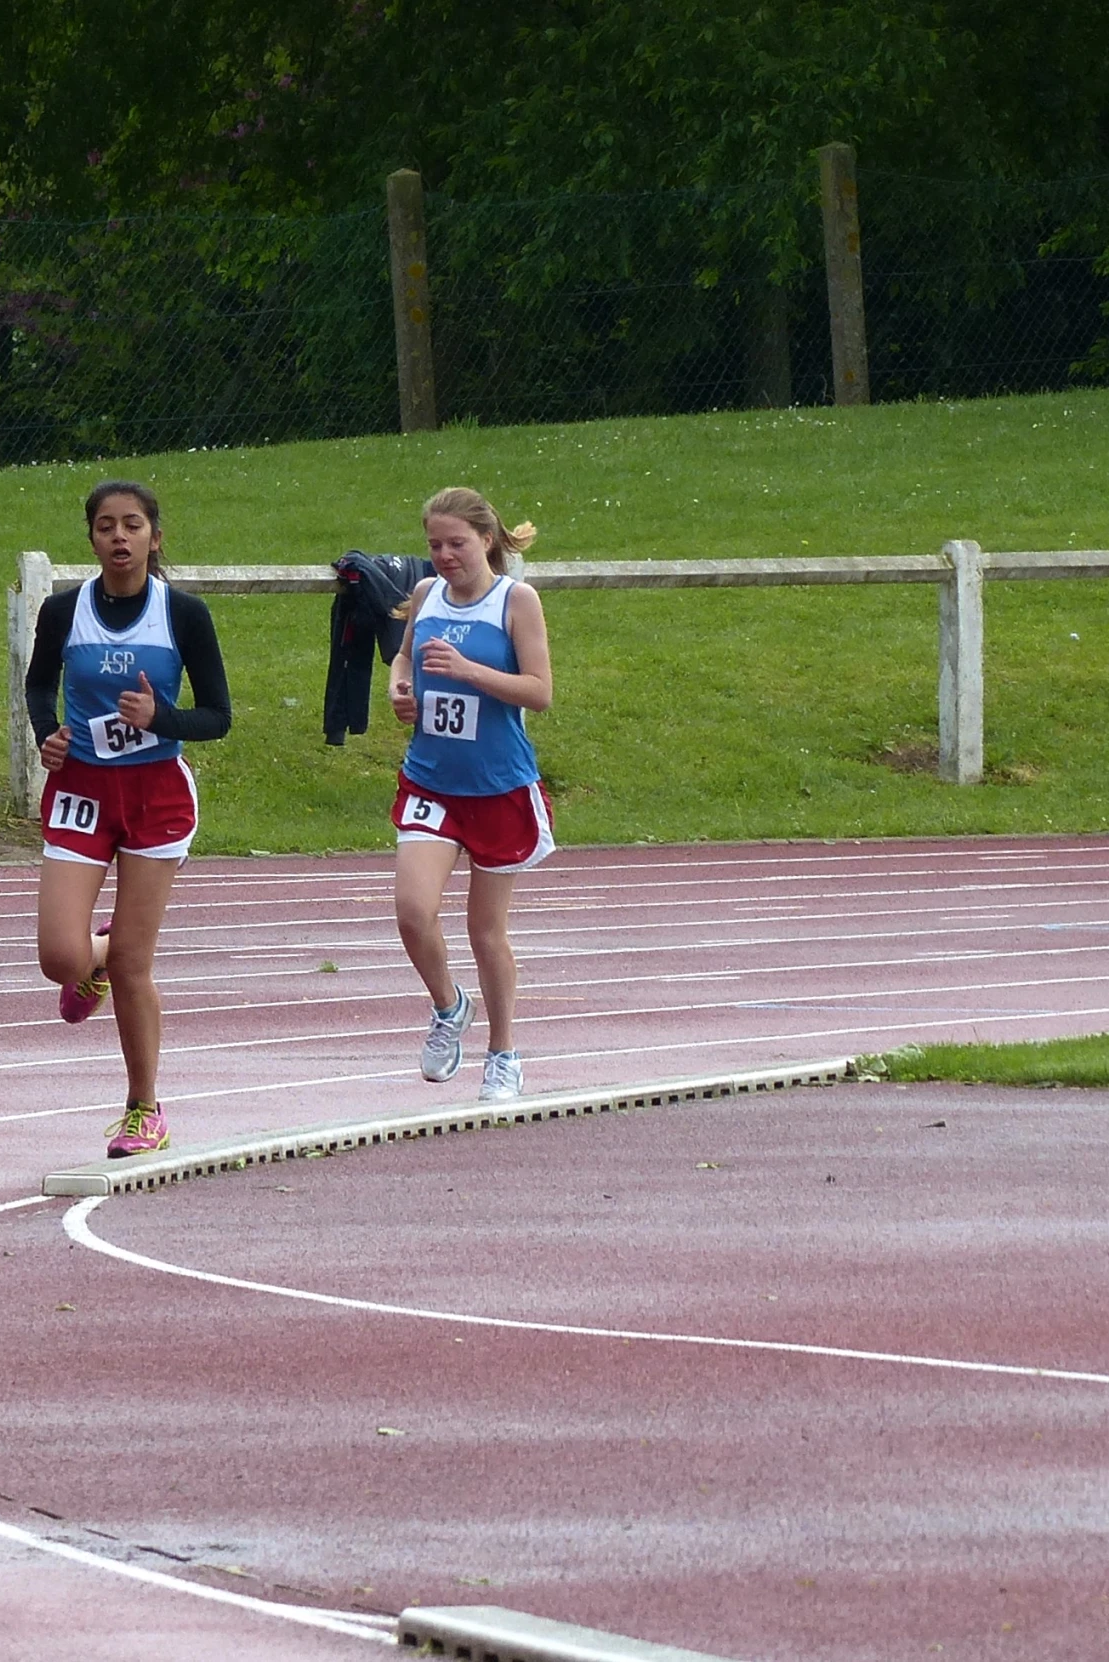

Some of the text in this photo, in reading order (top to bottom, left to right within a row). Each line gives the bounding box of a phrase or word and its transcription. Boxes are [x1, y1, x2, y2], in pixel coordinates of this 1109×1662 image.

[433, 696, 465, 735] 53
[104, 718, 143, 752] 54
[59, 796, 93, 829] 10
[413, 799, 431, 820] 5
